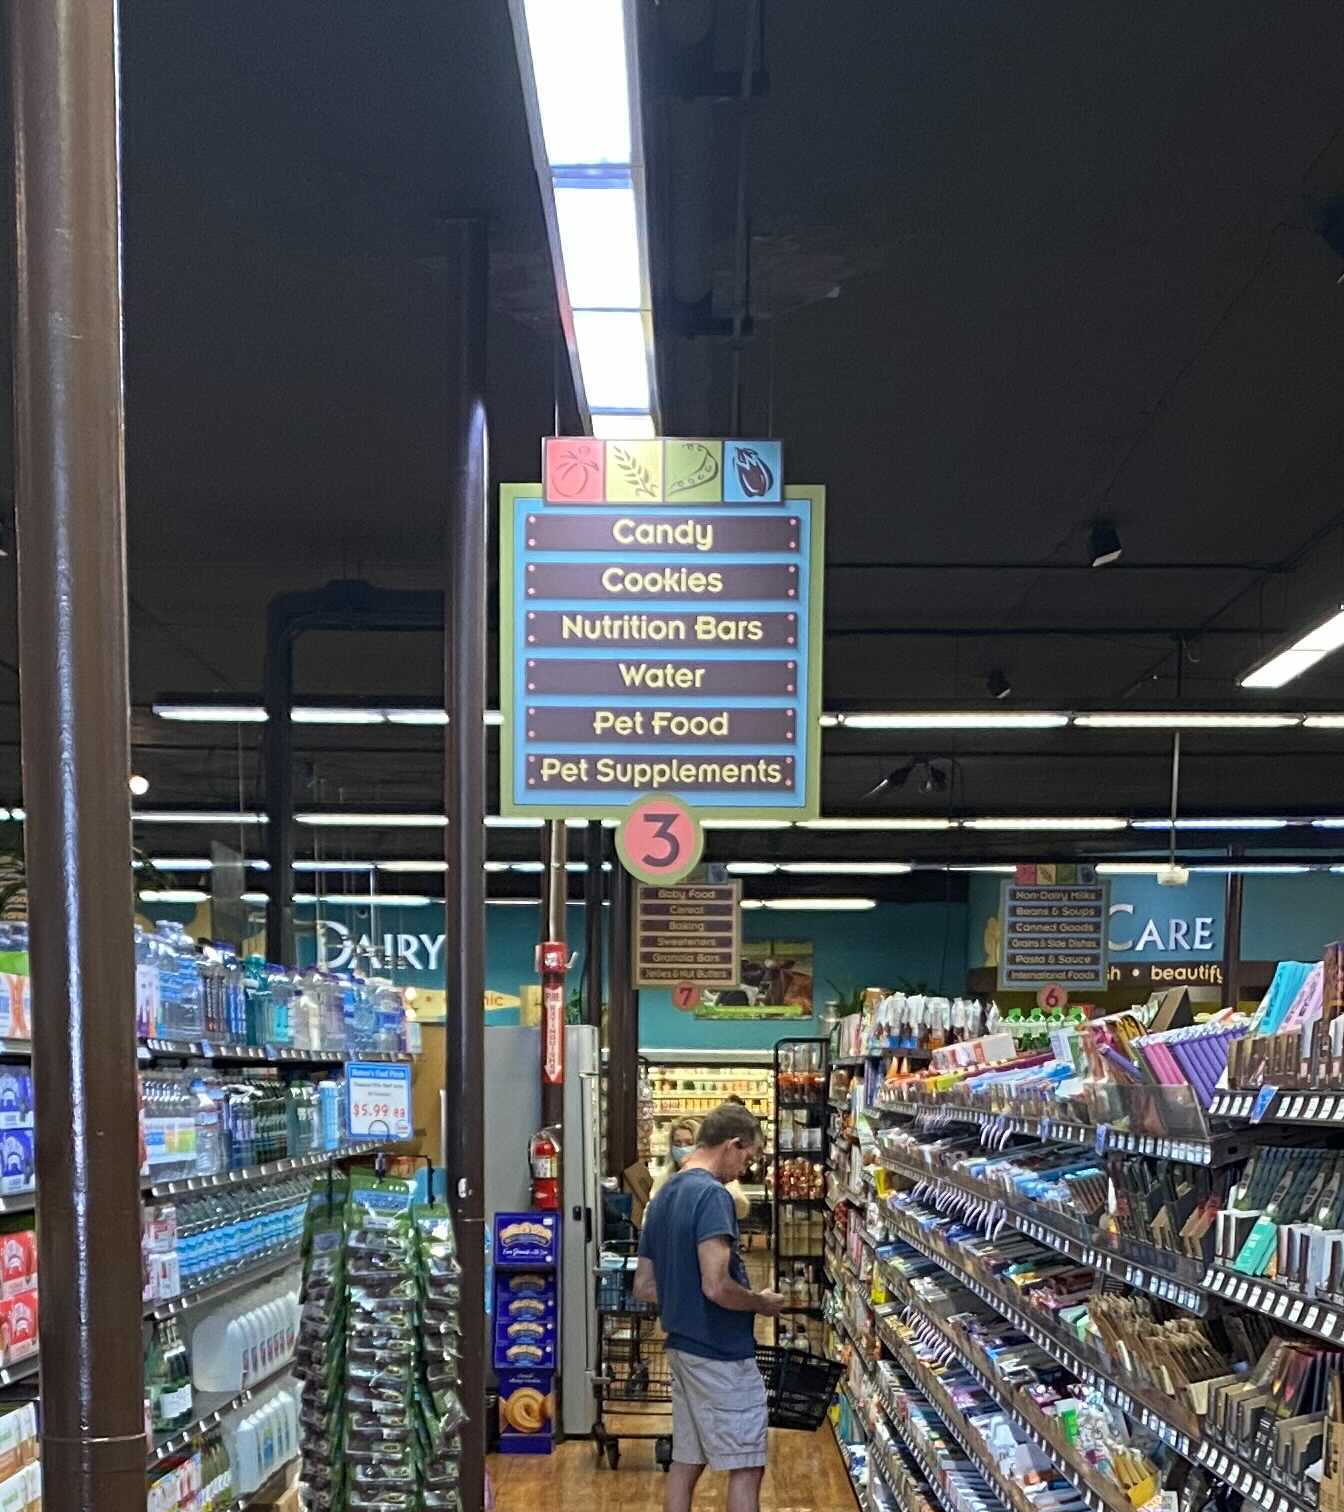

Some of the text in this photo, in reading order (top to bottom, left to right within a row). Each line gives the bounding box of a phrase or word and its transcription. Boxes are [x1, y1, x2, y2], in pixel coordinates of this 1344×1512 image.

[612, 520, 713, 550] Candy
[602, 568, 723, 593] Cookies
[561, 616, 763, 640] Nutrition Bars
[618, 663, 705, 688] Water
[593, 711, 728, 735] Pet Food
[541, 758, 782, 788] Pet Supplements
[641, 813, 681, 867] 3
[1016, 906, 1049, 916] Beans
[1061, 906, 1095, 917] Soups
[1016, 922, 1094, 933] Canned Goods
[1108, 904, 1214, 951] CARE
[317, 919, 447, 970] DAIRY
[1015, 954, 1046, 965] Pasta
[1058, 954, 1092, 965] Sauce
[1151, 965, 1224, 984] beautify
[679, 987, 693, 1006] 7
[1046, 988, 1057, 1007] 6
